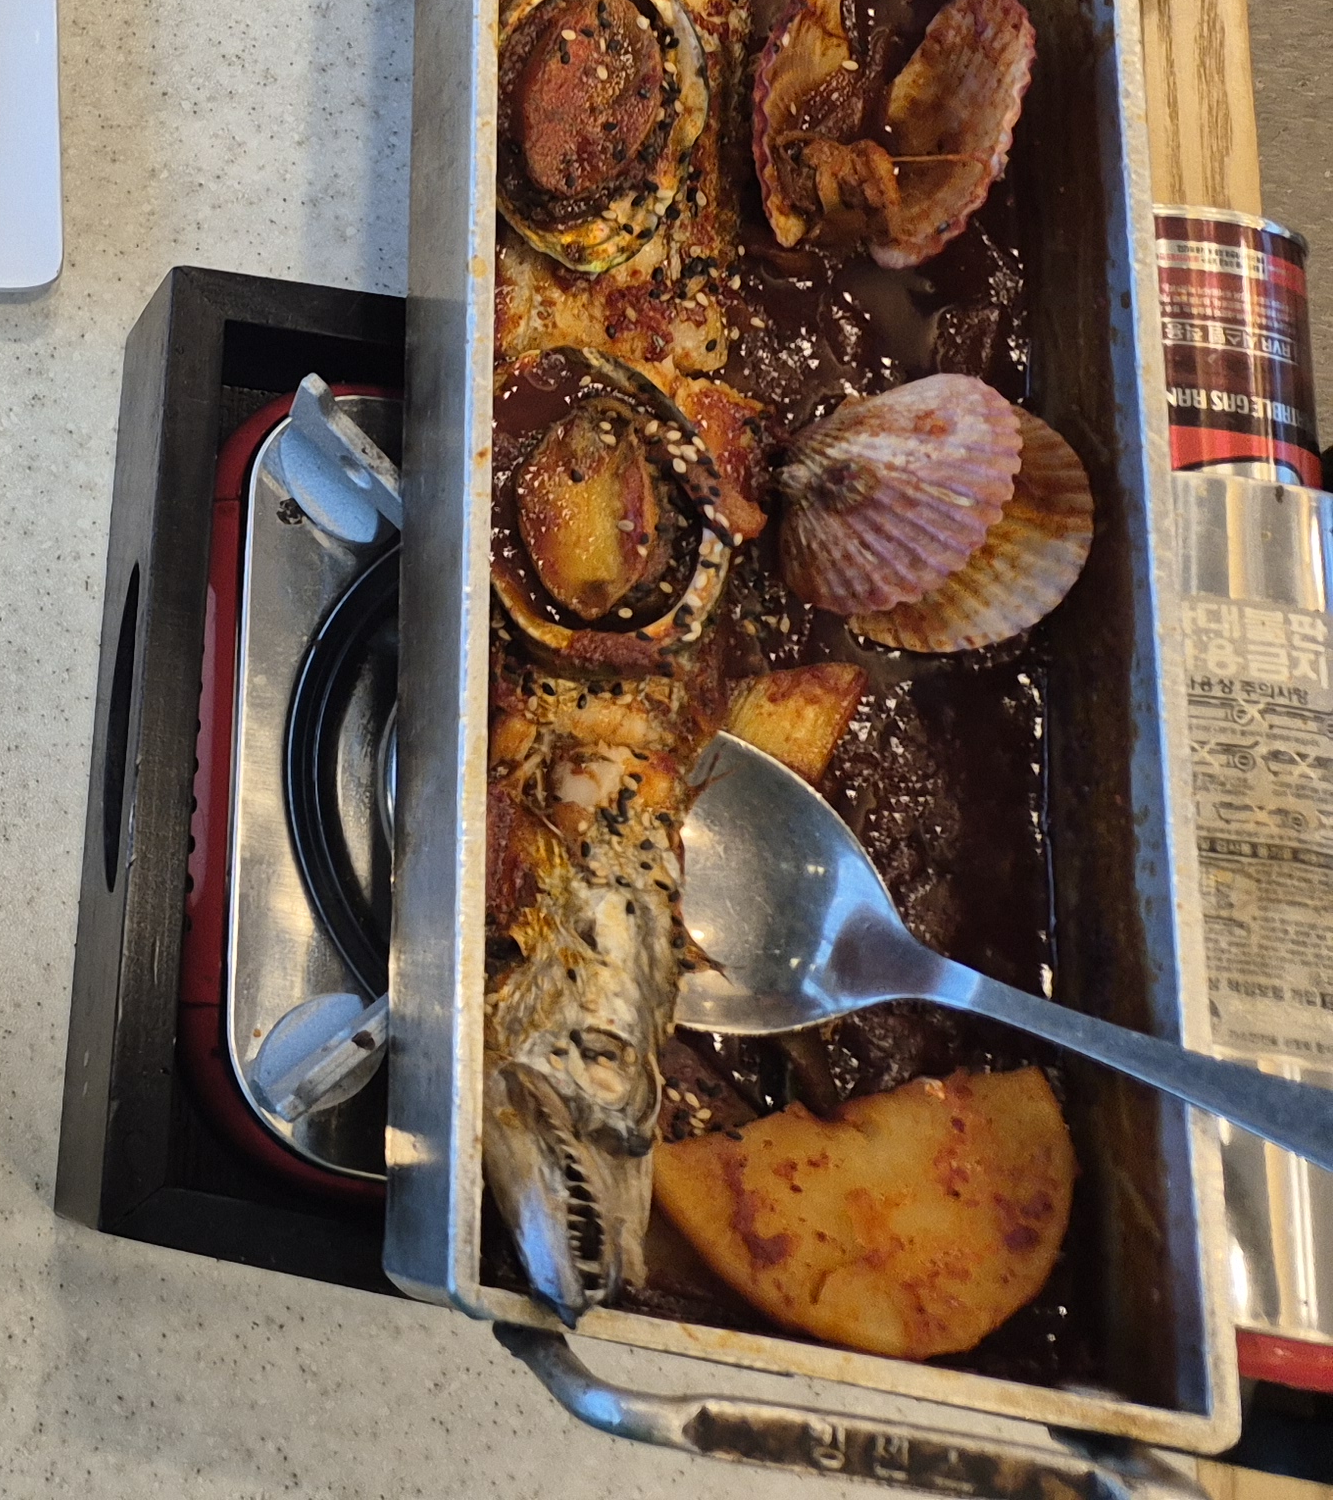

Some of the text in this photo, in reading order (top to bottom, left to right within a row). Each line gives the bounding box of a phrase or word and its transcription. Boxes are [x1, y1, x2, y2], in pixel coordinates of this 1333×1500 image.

[1262, 336, 1292, 358] RVR
[1211, 390, 1250, 416] GAS
[1250, 396, 1305, 429] TABLE
[1238, 679, 1309, 706] 주의사항
